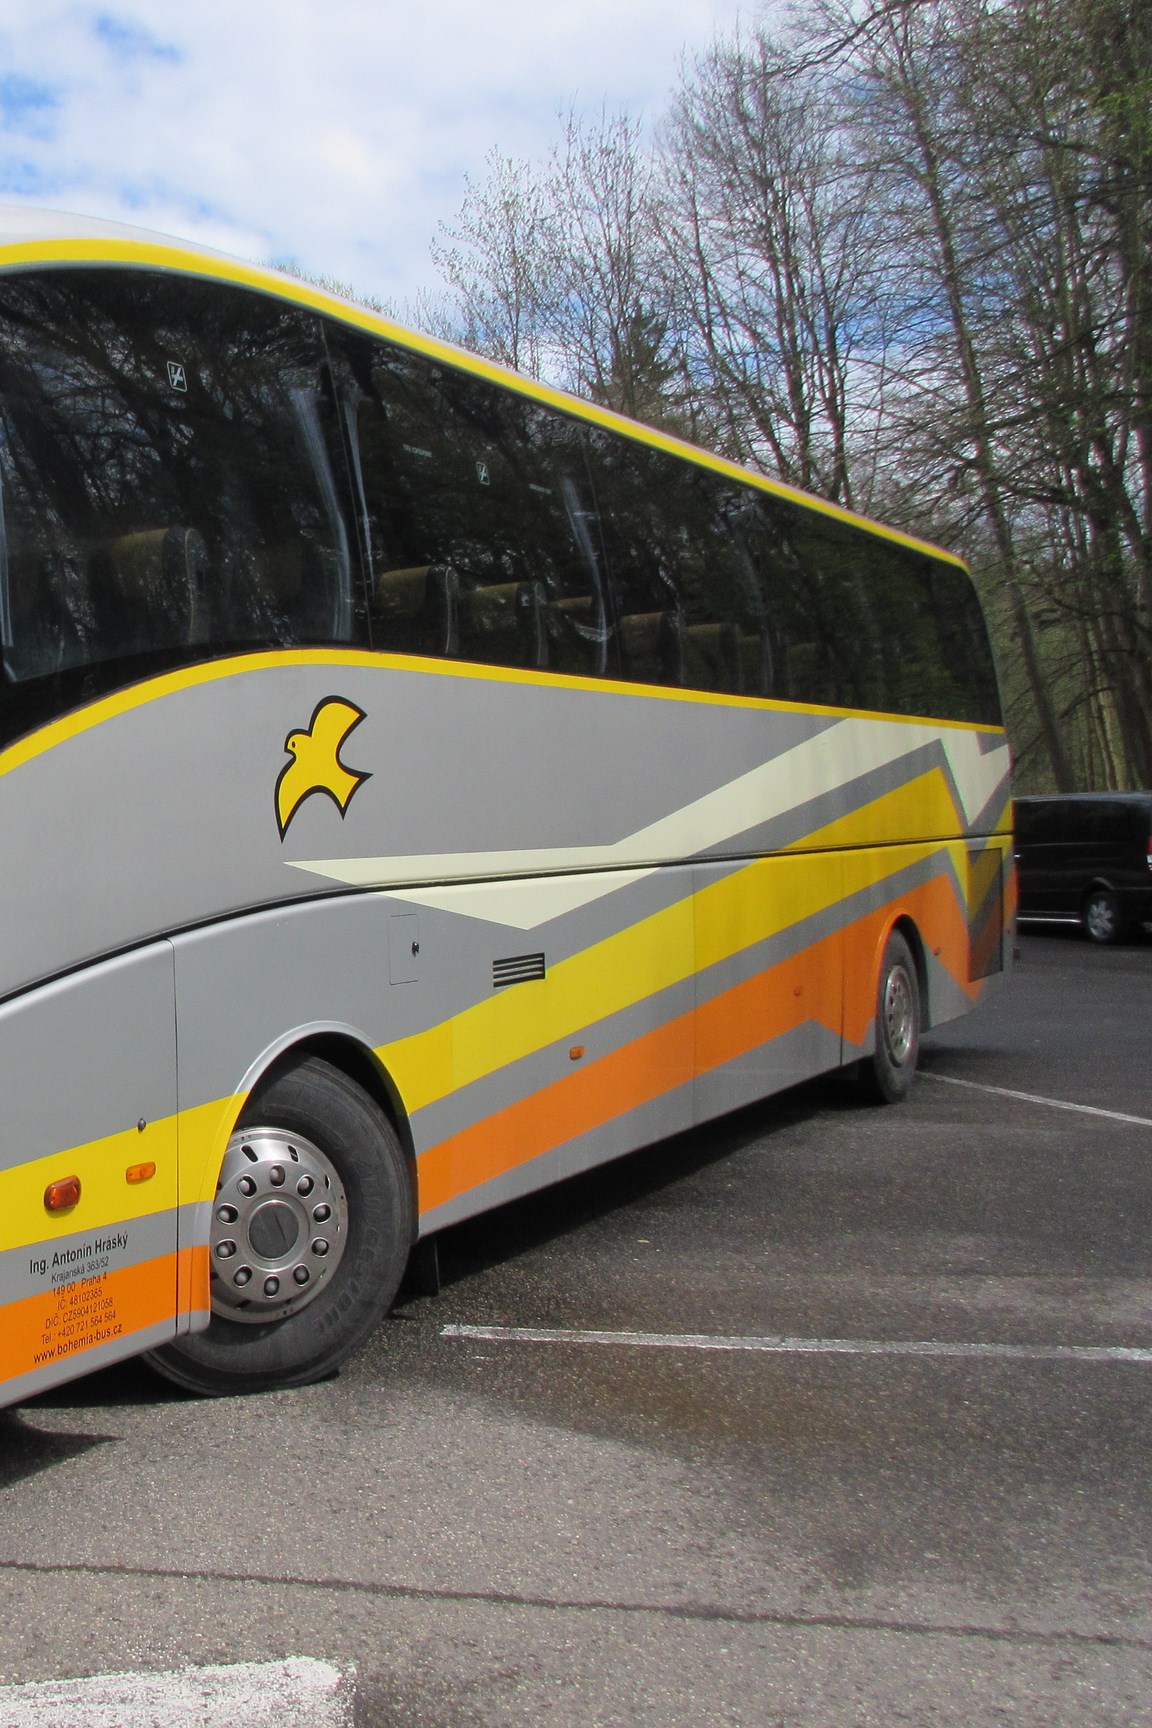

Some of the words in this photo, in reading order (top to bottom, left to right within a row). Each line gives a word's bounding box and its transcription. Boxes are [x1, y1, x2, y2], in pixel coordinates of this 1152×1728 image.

[29, 1259, 49, 1276] Ing.
[52, 1243, 92, 1267] Antonín
[95, 1231, 129, 1254] Hráský
[51, 1265, 85, 1284] Krajanská
[52, 1285, 65, 1298] 149
[66, 1281, 76, 1293] 00
[81, 1274, 101, 1289] Praha
[102, 1271, 108, 1281] 4
[57, 1324, 75, 1338] +420
[76, 1320, 89, 1333] 721
[90, 1315, 103, 1327] 564
[104, 1310, 117, 1323] 564
[33, 1323, 123, 1364] www.bohemia-bus.cz
